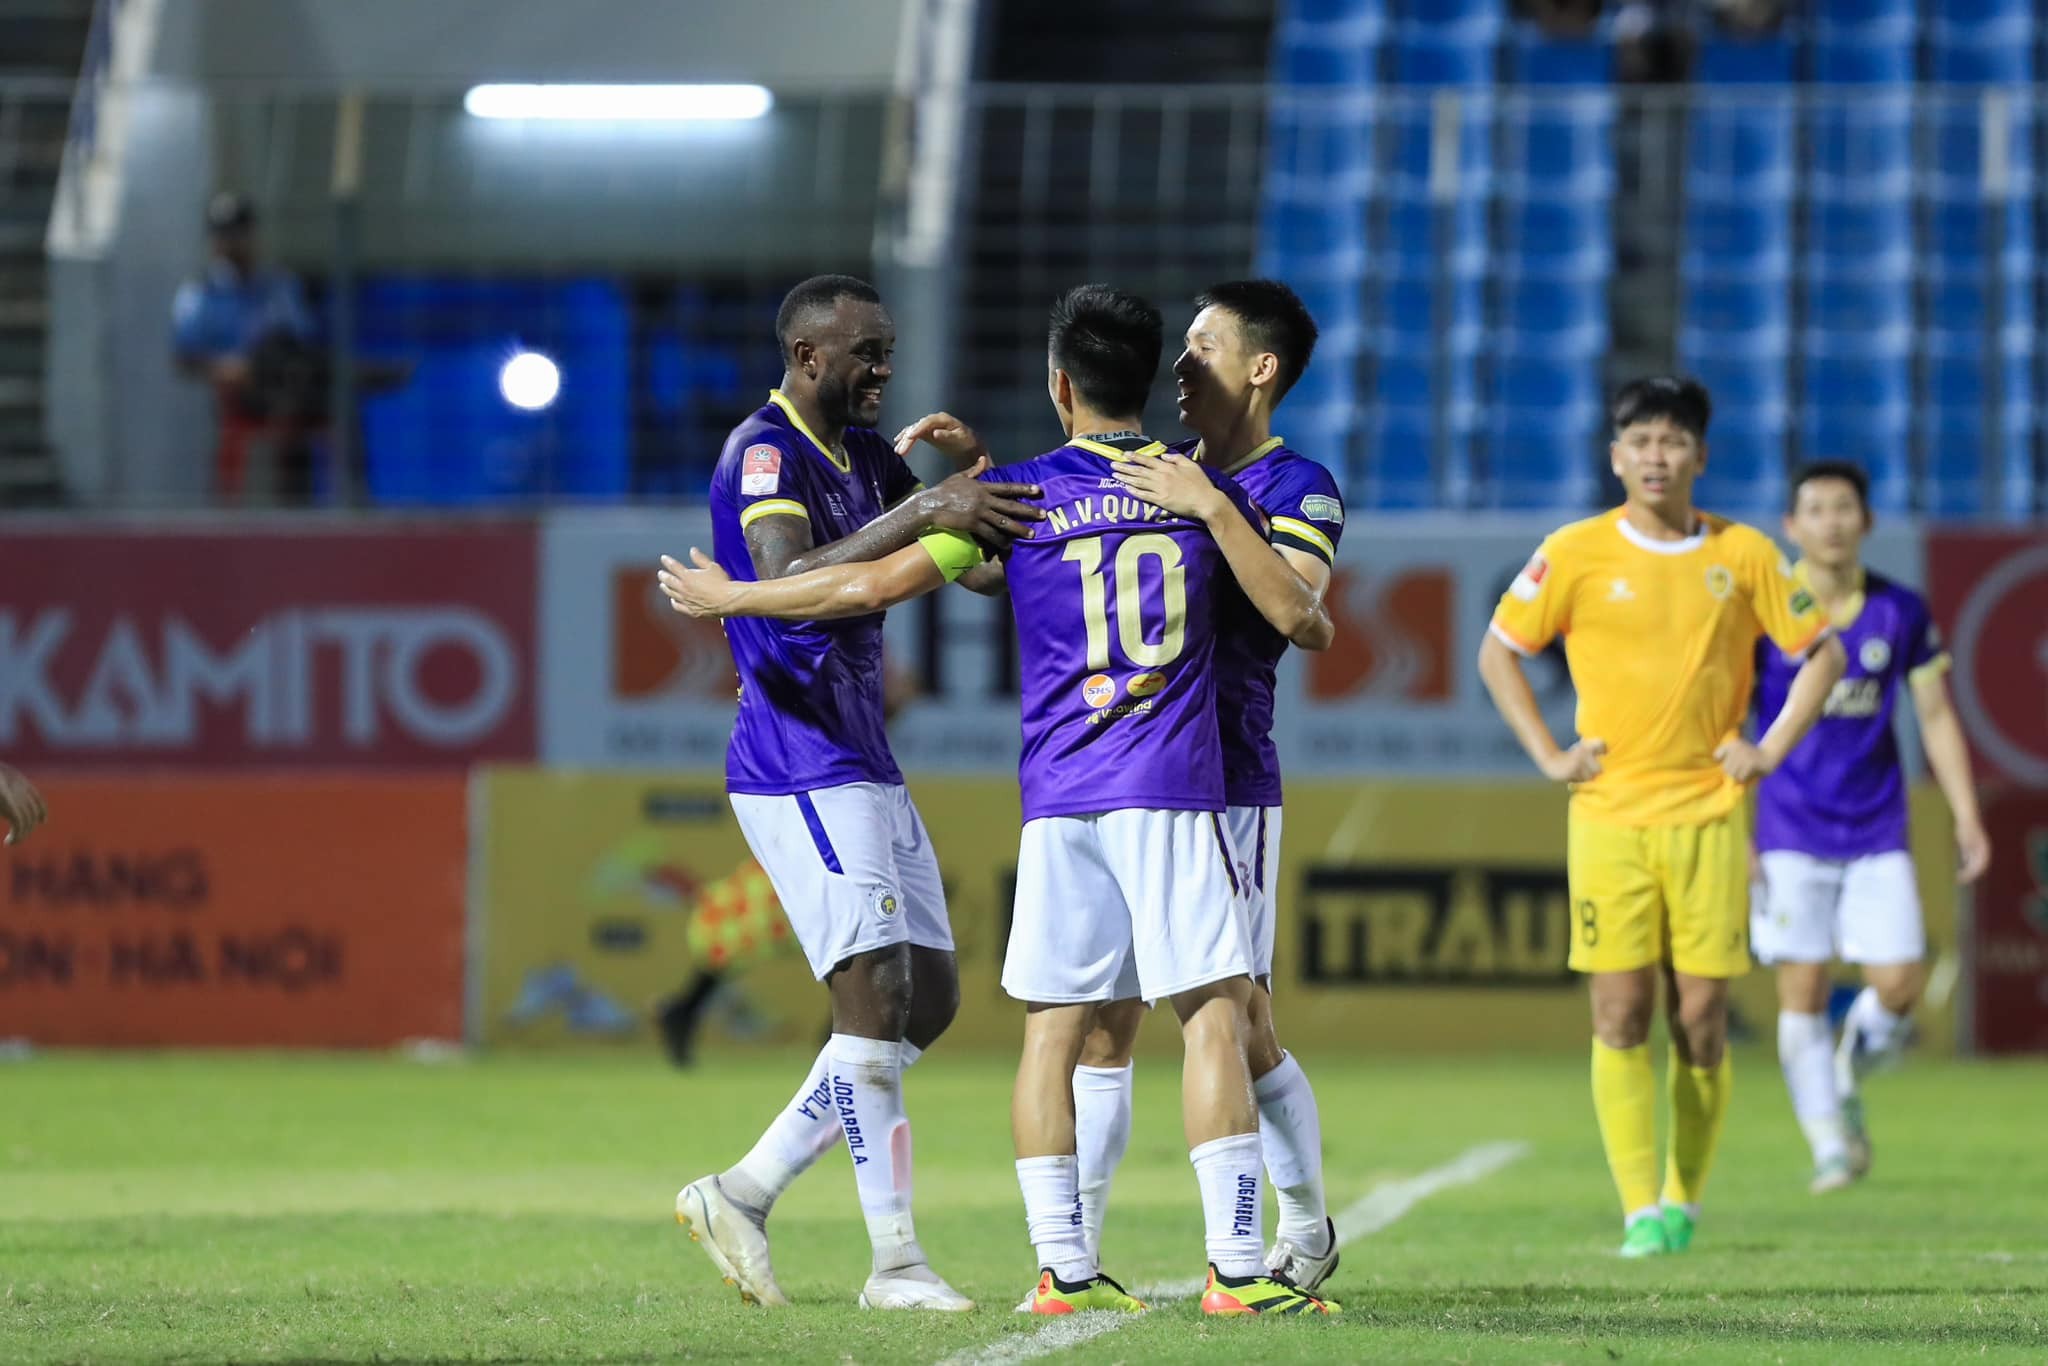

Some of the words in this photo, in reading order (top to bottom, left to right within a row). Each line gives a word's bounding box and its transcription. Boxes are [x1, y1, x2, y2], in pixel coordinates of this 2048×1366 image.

[1047, 494, 1179, 535] N.V.QUY
[1061, 532, 1187, 671] 10
[0, 606, 517, 748] KAMITO
[833, 1075, 869, 1165] JOGARBOLA
